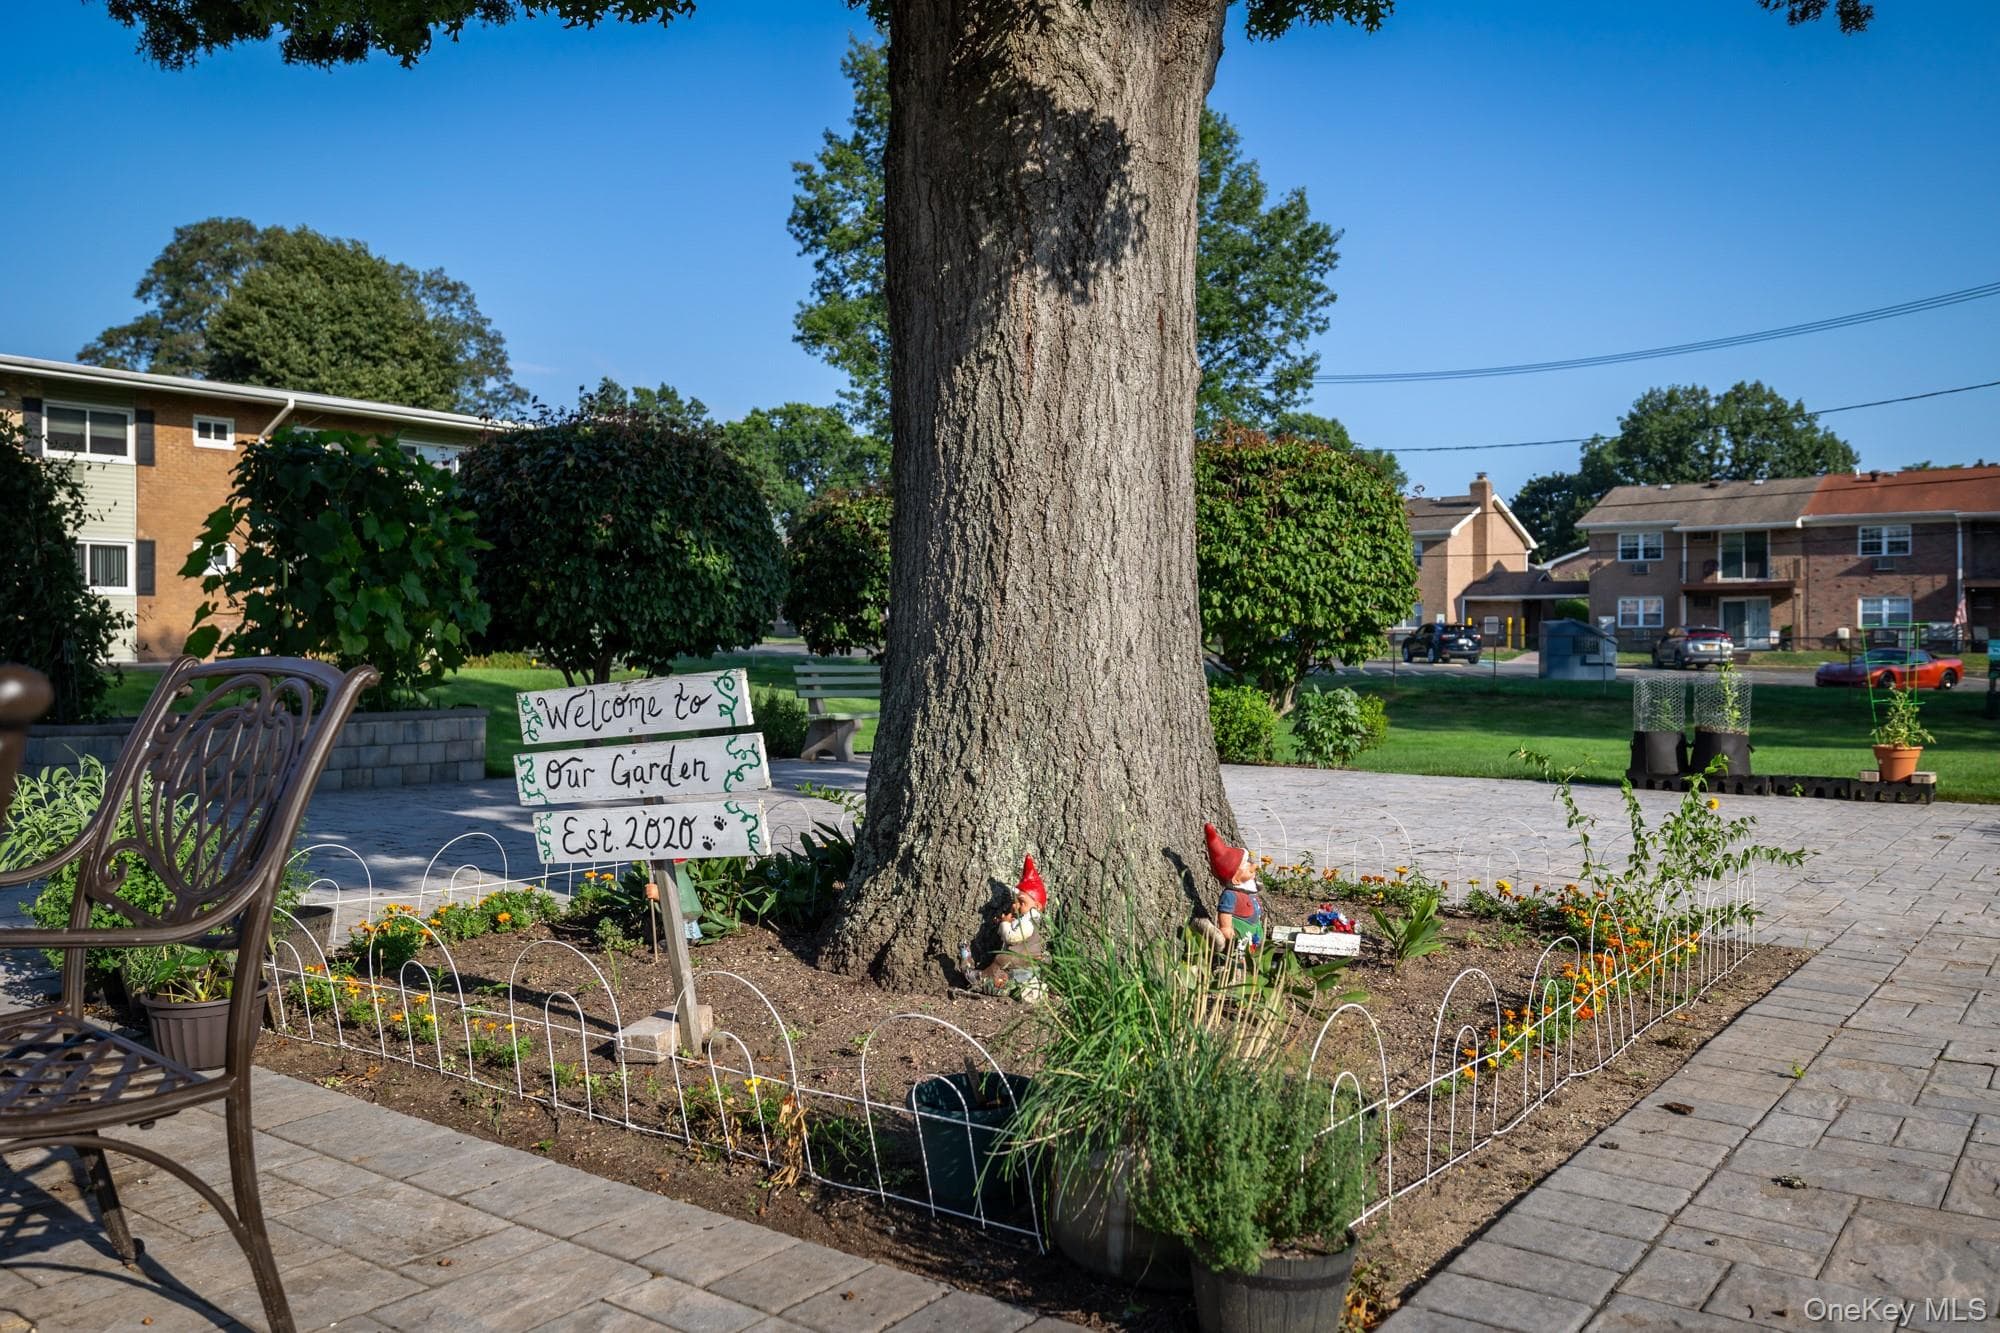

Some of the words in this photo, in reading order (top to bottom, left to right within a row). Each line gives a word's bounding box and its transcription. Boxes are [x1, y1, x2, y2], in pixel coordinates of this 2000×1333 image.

[537, 689, 663, 732] Welcome
[674, 682, 713, 720] to
[546, 757, 595, 789] Our
[611, 745, 710, 789] Garden
[562, 816, 619, 857] Est.
[625, 815, 698, 850] 2020
